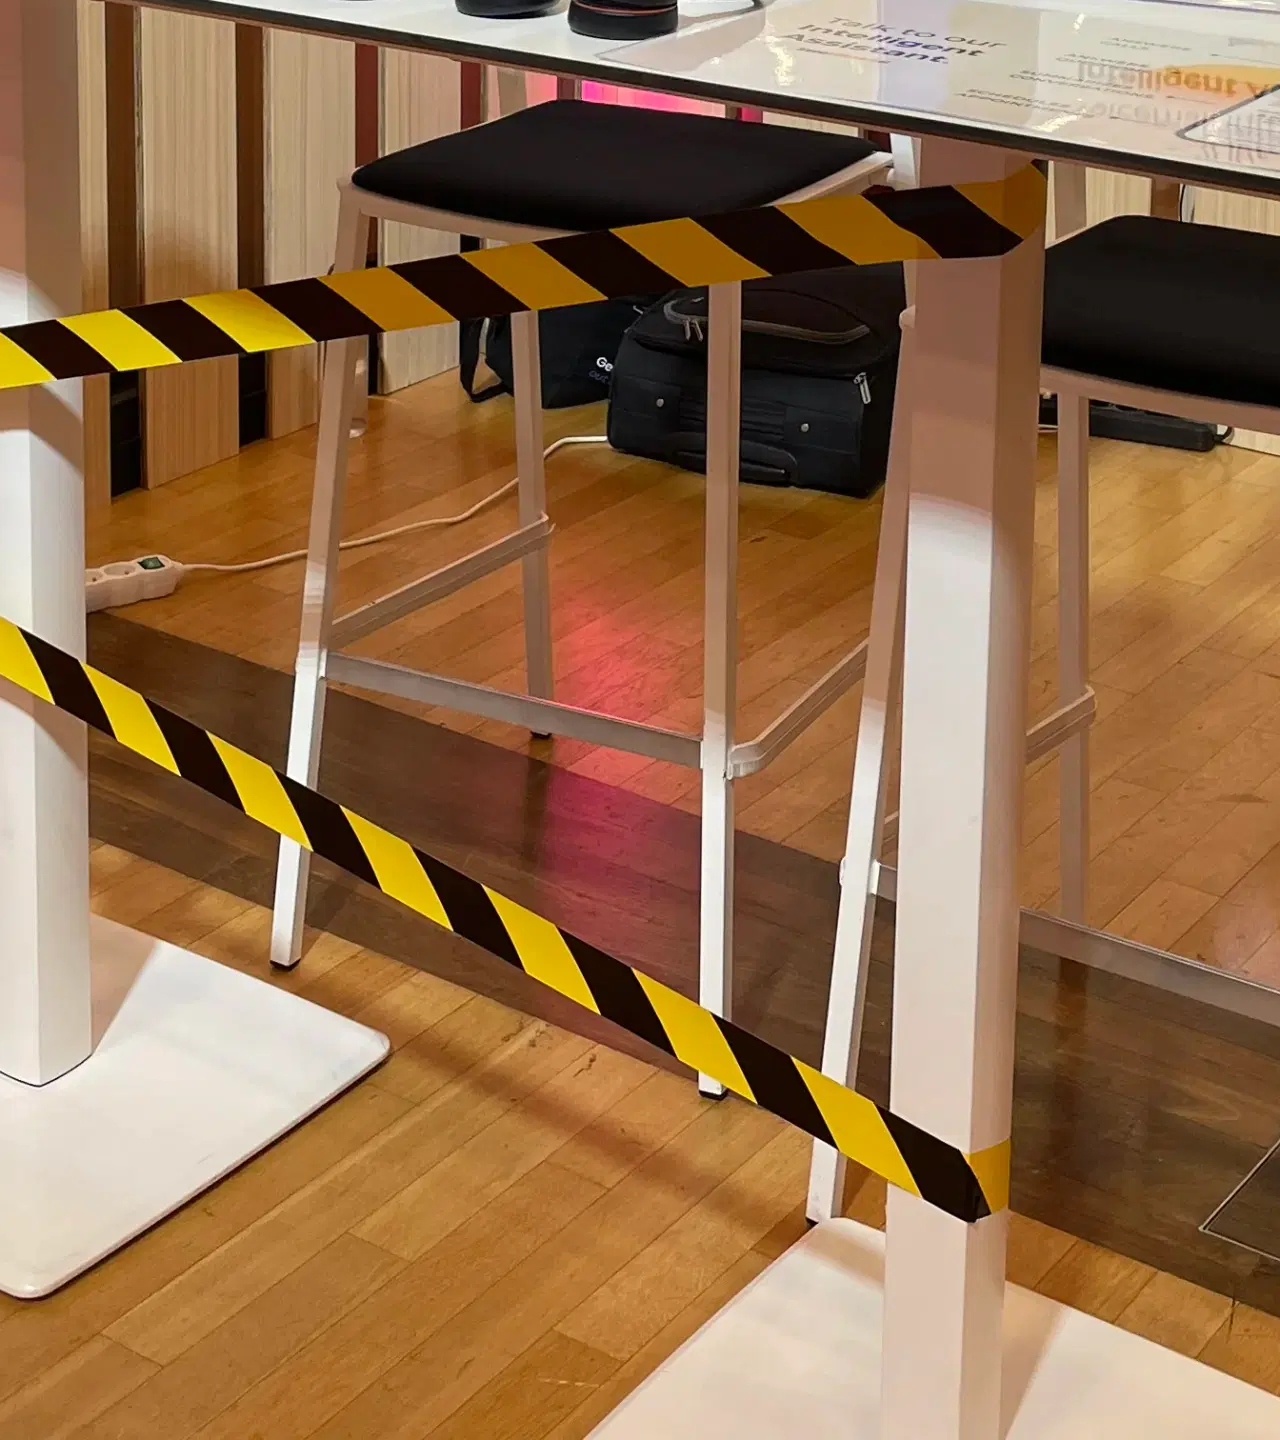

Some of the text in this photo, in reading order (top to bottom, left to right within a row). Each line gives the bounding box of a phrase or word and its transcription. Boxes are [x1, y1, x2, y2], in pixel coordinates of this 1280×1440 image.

[797, 24, 986, 57] Intelligent
[828, 16, 1008, 48] Talk to our
[781, 34, 950, 64] Assistant.
